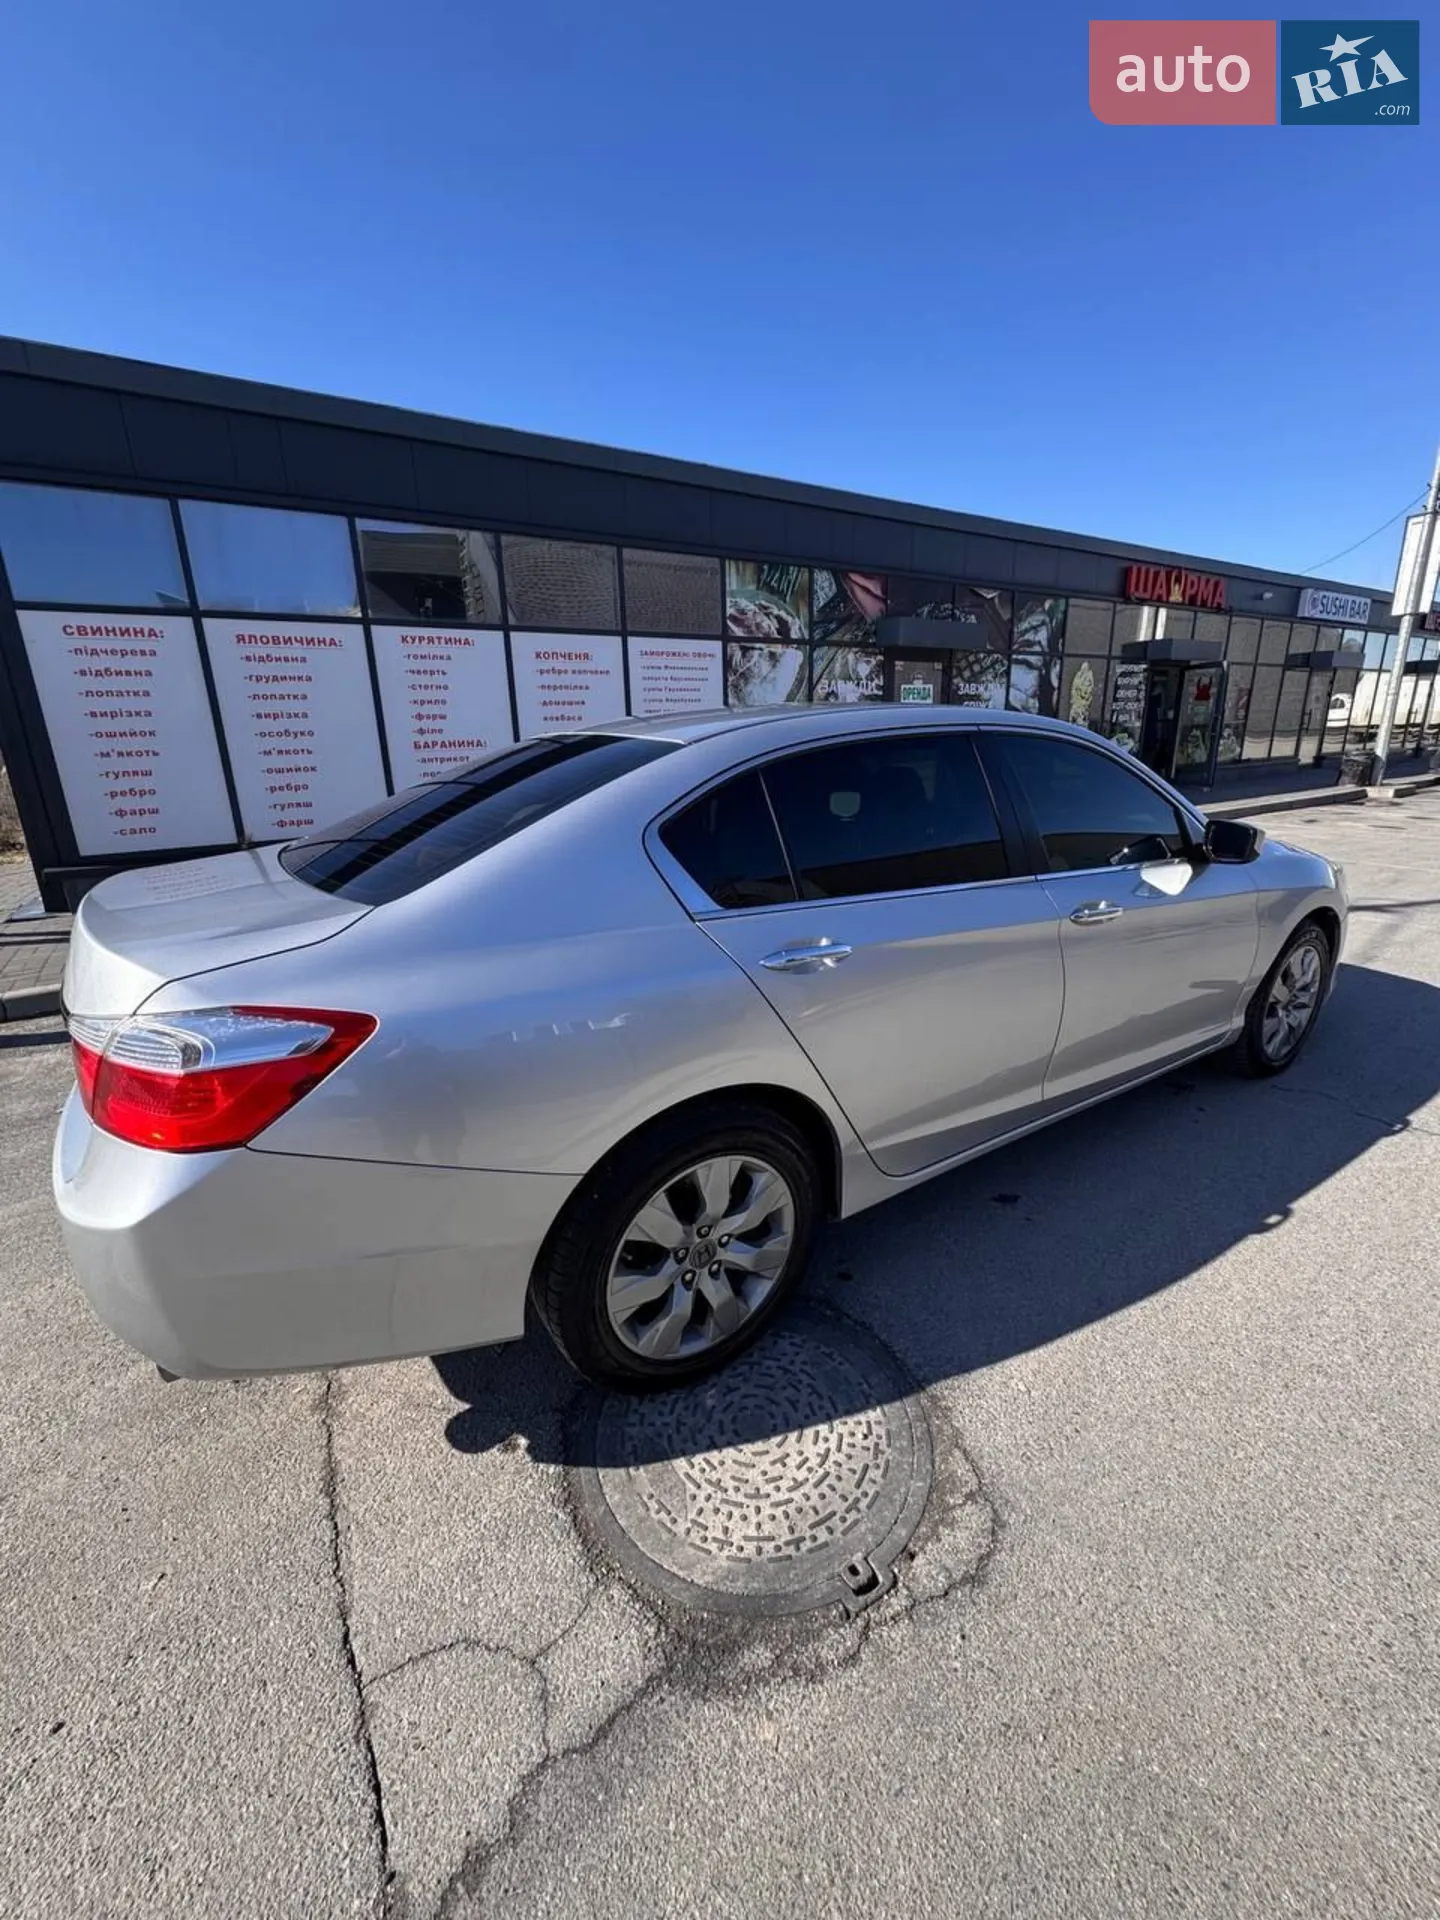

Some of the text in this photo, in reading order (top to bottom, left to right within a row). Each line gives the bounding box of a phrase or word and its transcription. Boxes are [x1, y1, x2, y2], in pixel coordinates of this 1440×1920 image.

[1320, 594, 1369, 619] SUSHI BAR
[62, 624, 165, 639] СВИНИНА:
[235, 634, 343, 648] ЯЛОВИЧИНА:
[401, 635, 475, 646] КУРЯТИНА:
[68, 646, 157, 658] -підчерева
[535, 651, 593, 661] КОПЧЕНЯ:
[240, 654, 307, 664] -відбивна
[73, 667, 153, 679] -відбивна
[243, 674, 312, 684] -грудинка
[902, 686, 931, 700] ОРЕНДА
[84, 708, 152, 720] -вирізка
[251, 710, 309, 721] -вирізка
[88, 729, 157, 738] -ошийок
[254, 729, 315, 739] -особуко
[413, 739, 487, 750] БАРАНИНА:
[265, 783, 309, 793] -ребро
[103, 788, 157, 800] -ребро
[109, 807, 160, 818] -фарш
[271, 818, 314, 828] -фарш
[113, 826, 157, 836] -сало
